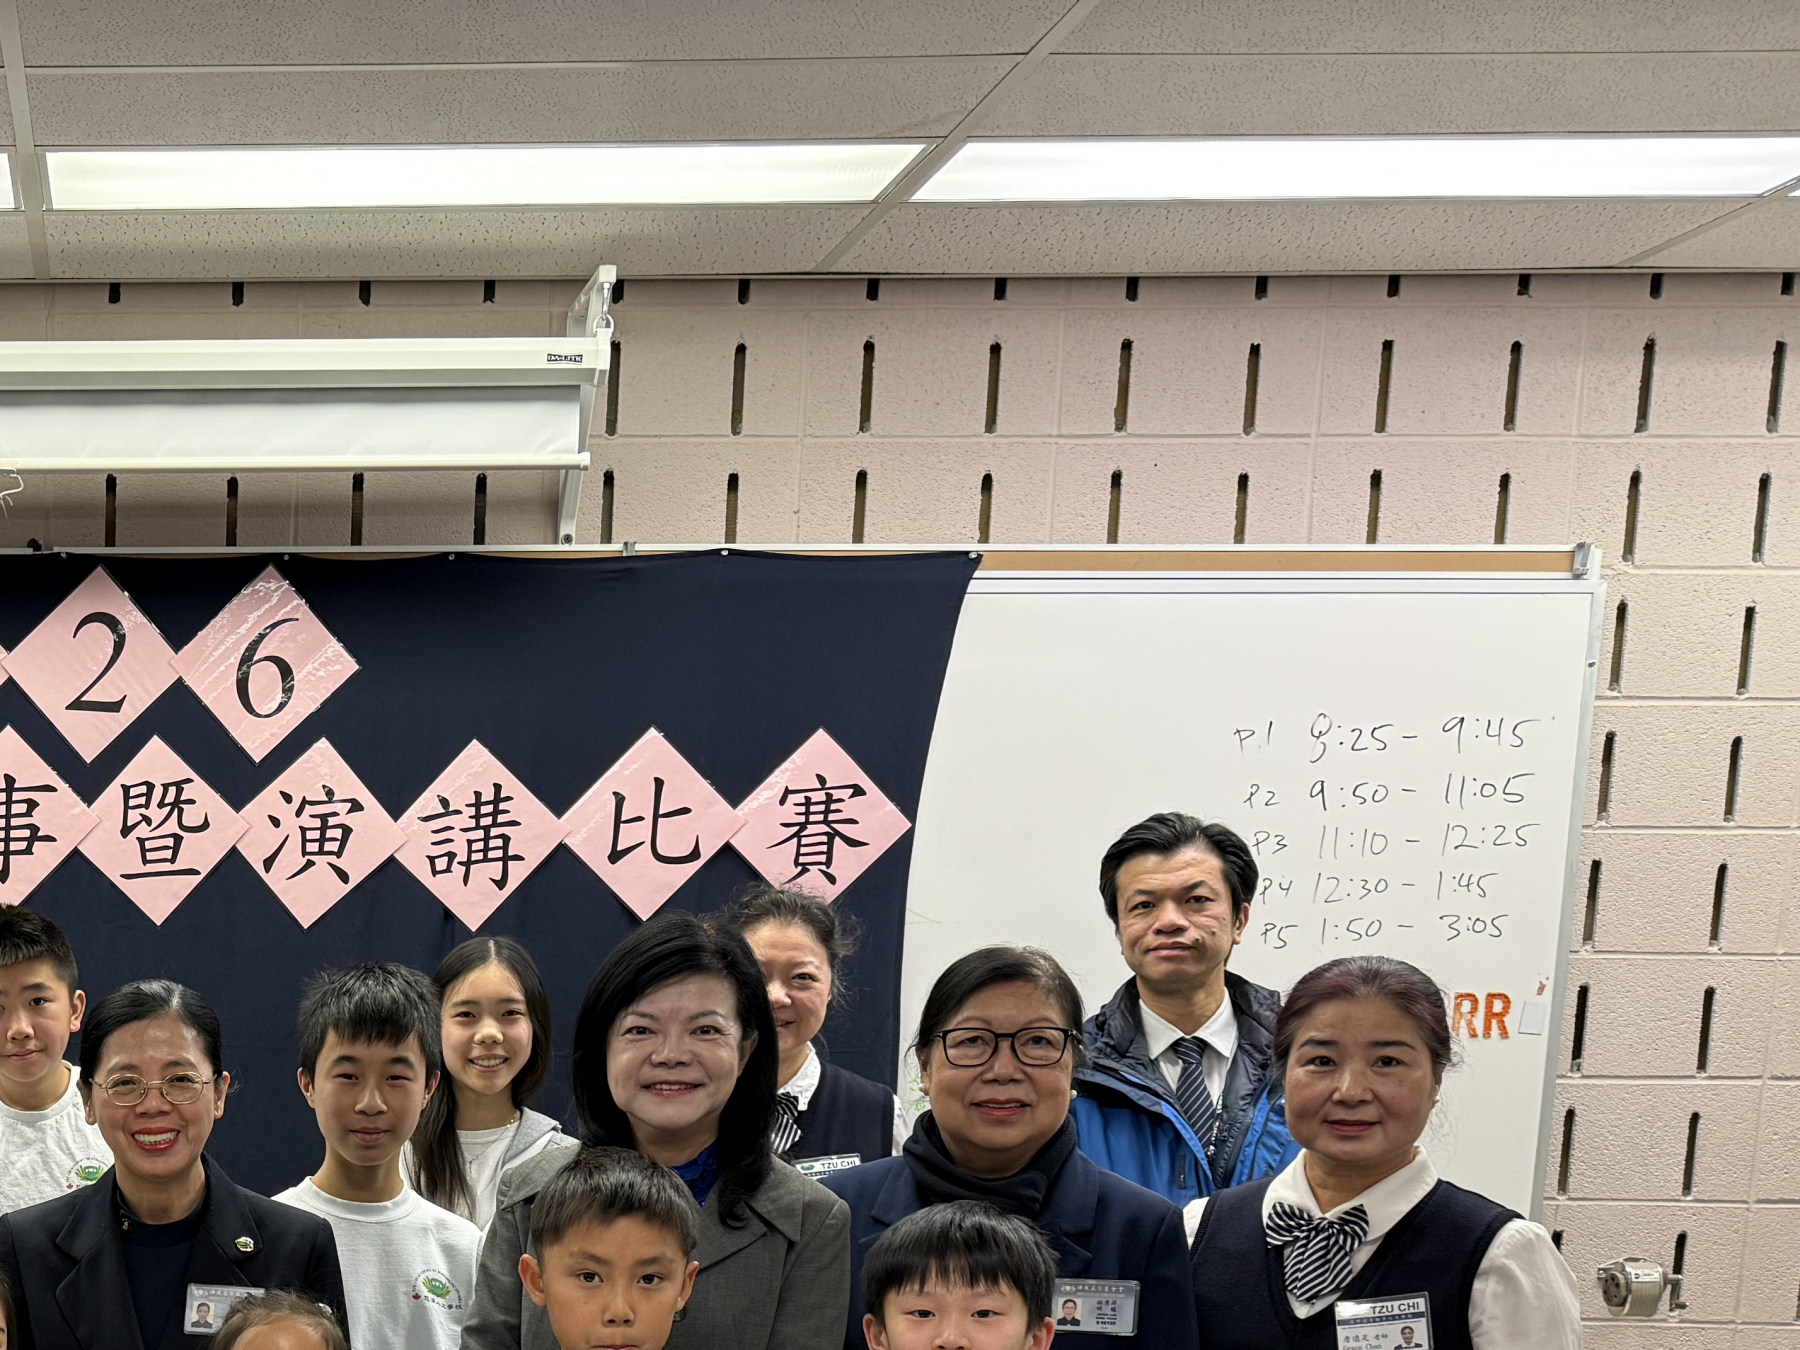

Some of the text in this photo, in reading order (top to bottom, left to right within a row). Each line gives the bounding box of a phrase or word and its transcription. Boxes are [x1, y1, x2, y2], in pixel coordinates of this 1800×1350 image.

[1309, 712, 1394, 763] 8:25
[1442, 716, 1541, 753] 9:45
[1243, 784, 1280, 808] P2
[1309, 780, 1389, 811] 9:50
[1445, 773, 1535, 809] 11:05
[1252, 831, 1287, 855] P3
[1319, 825, 1387, 859] 11:10
[1441, 823, 1540, 856] 12:25
[1313, 873, 1388, 903] 12:30
[1437, 871, 1498, 900] 1:45
[1260, 922, 1298, 949] P5
[1322, 917, 1382, 944] 1:50
[1439, 914, 1509, 941] 3:05
[821, 1160, 856, 1170] TZU CHI
[1370, 1301, 1420, 1315] TZU CHI
